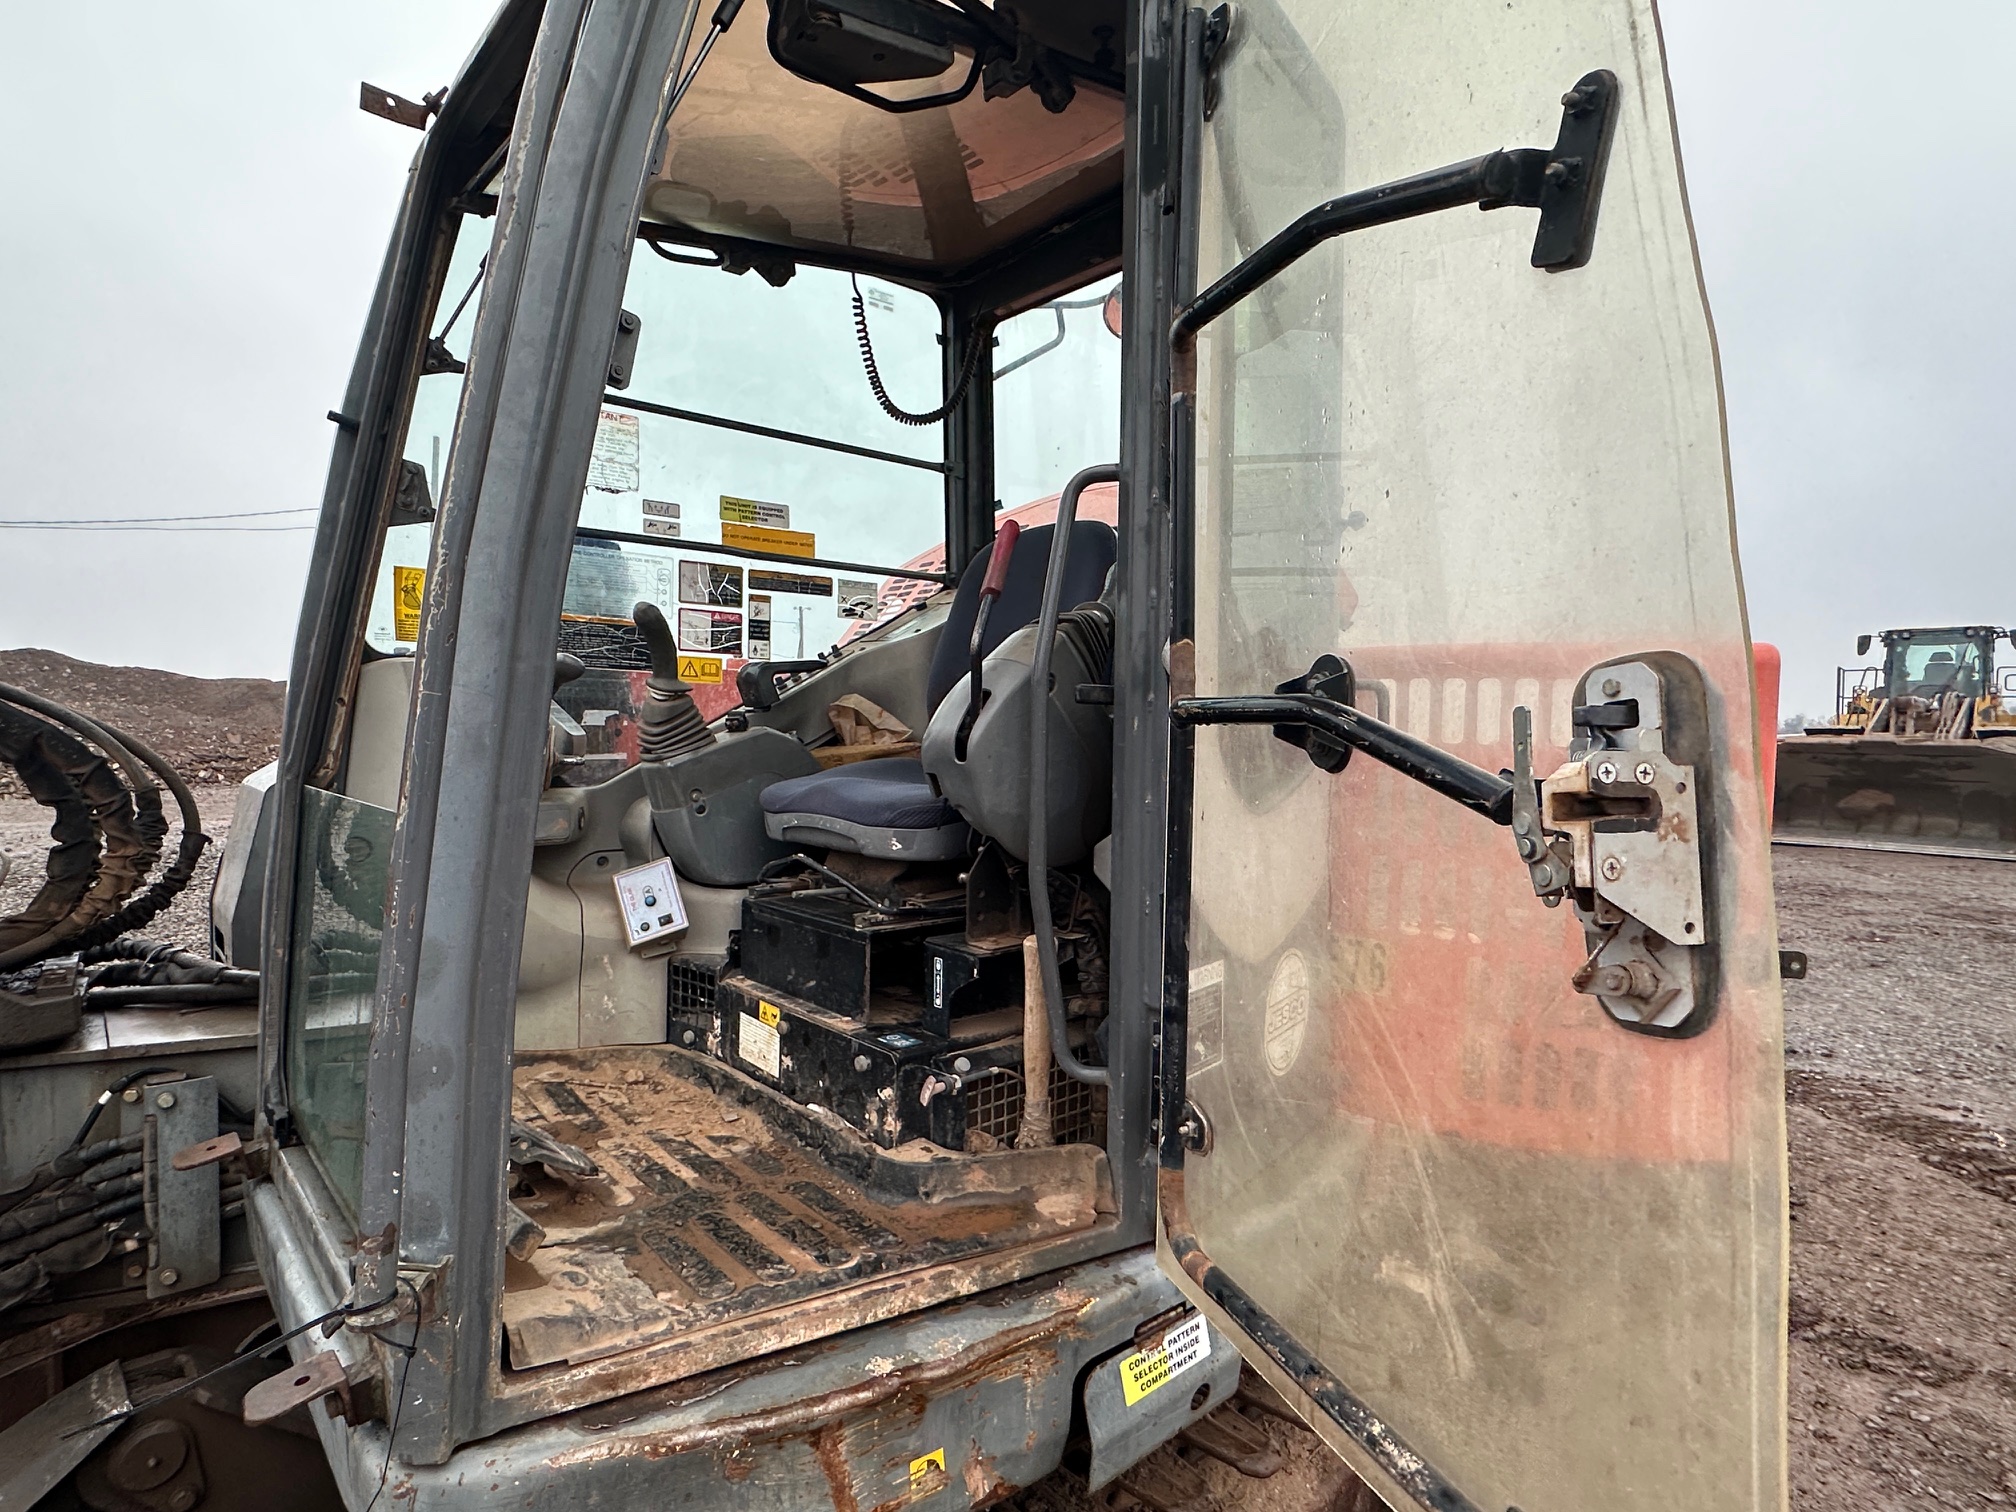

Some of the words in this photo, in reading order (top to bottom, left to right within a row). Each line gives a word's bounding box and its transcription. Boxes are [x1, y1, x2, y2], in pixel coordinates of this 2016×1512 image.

[738, 508, 761, 516] PATTERN
[759, 505, 783, 513] EQUIPPED
[1268, 996, 1305, 1034] JESCO
[1168, 1322, 1200, 1348] PATTERN
[1133, 1353, 1173, 1382] SELECTOR
[1175, 1335, 1200, 1357] INSIDE
[1140, 1350, 1198, 1392] COMPARTMENT
